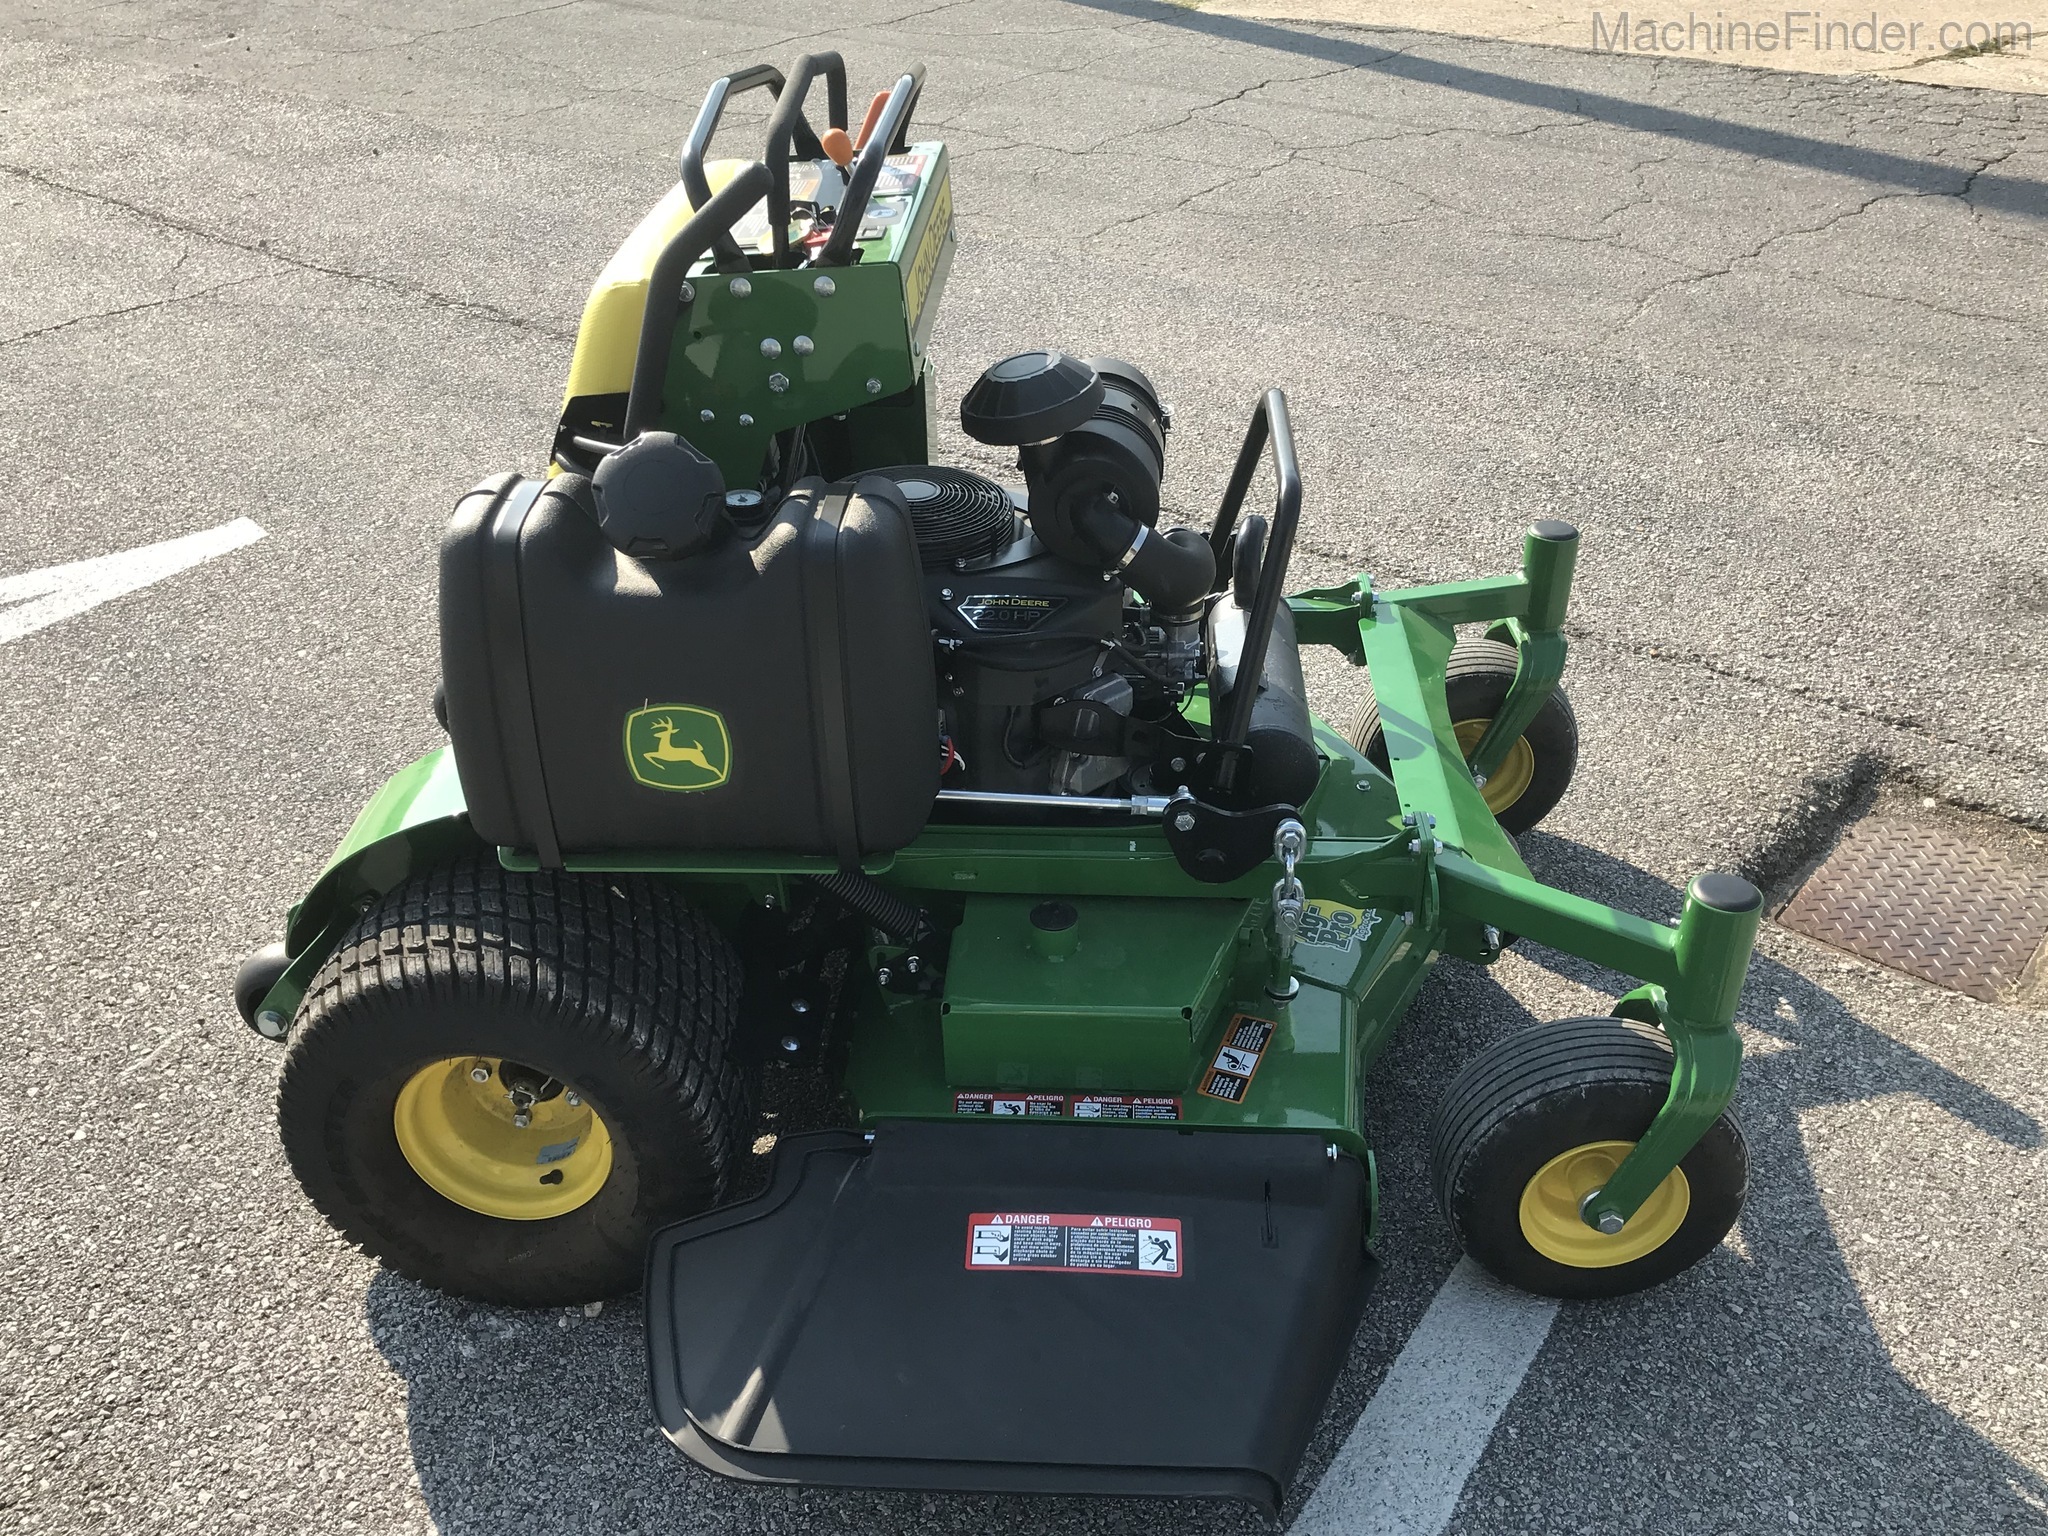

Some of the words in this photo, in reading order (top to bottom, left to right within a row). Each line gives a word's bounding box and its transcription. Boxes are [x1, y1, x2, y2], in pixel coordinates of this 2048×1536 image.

[1011, 598, 1050, 607] DEERE
[972, 609, 1010, 621] 22.0
[1013, 612, 1041, 621] HP
[1297, 906, 1329, 943] Ag-
[1317, 911, 1355, 949] Pro
[1005, 1214, 1050, 1225] DANGER
[1105, 1217, 1152, 1228] PELIGRO
